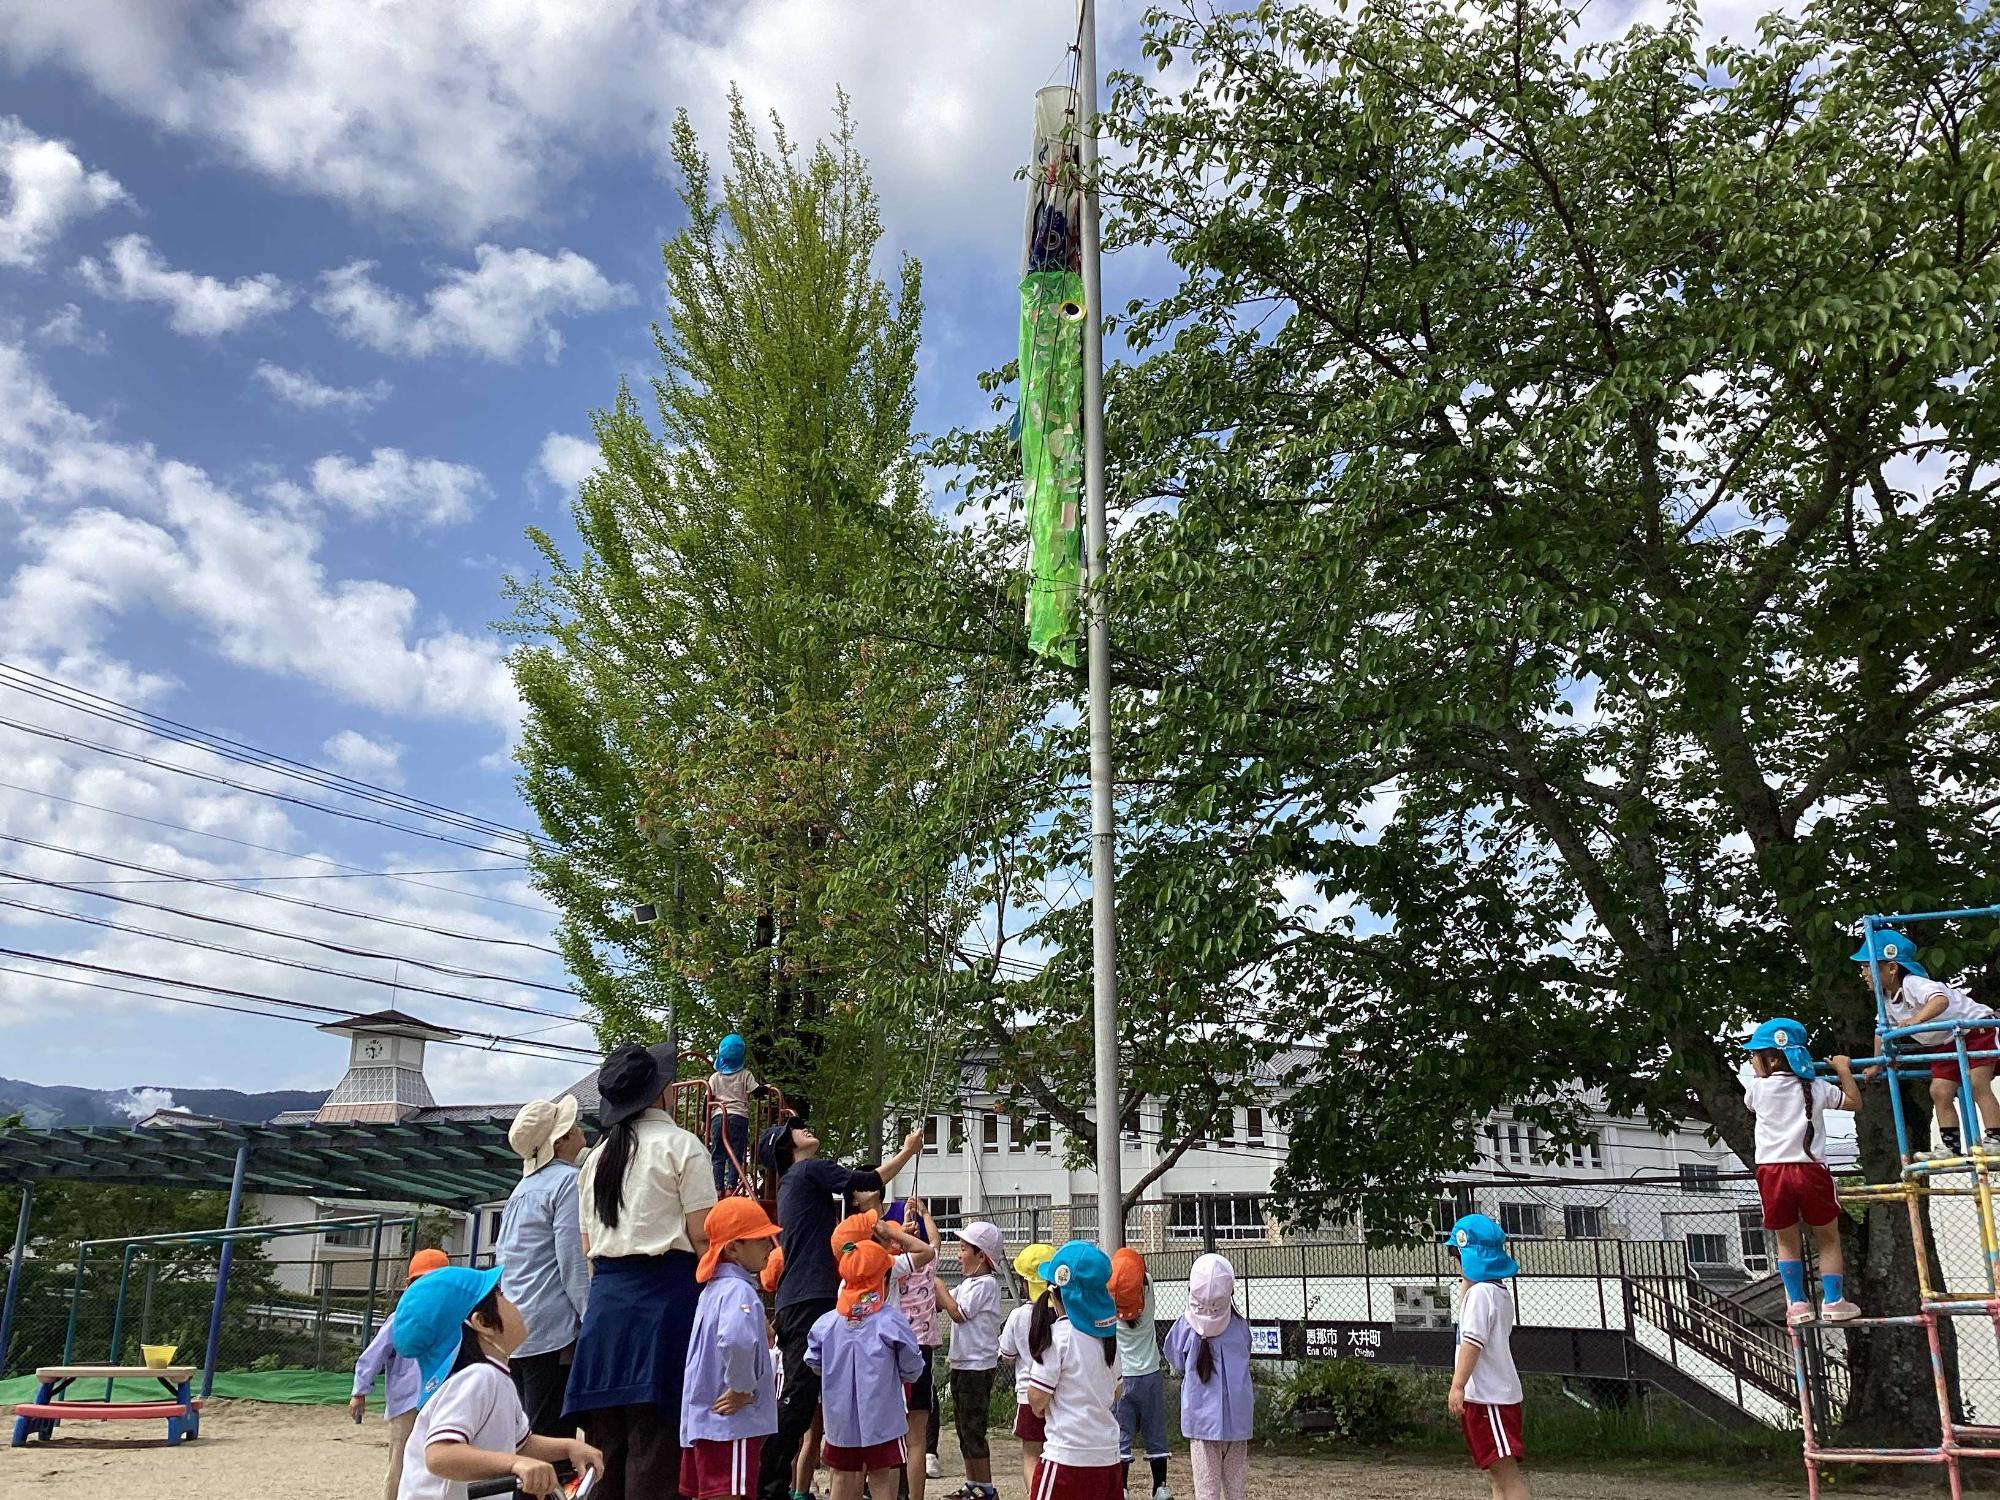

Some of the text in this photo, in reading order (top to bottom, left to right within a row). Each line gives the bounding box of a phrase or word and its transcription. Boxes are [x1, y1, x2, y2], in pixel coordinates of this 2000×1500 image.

[1306, 1328, 1381, 1347] 恵那市 大井町
[1306, 1346, 1338, 1358] Ena City
